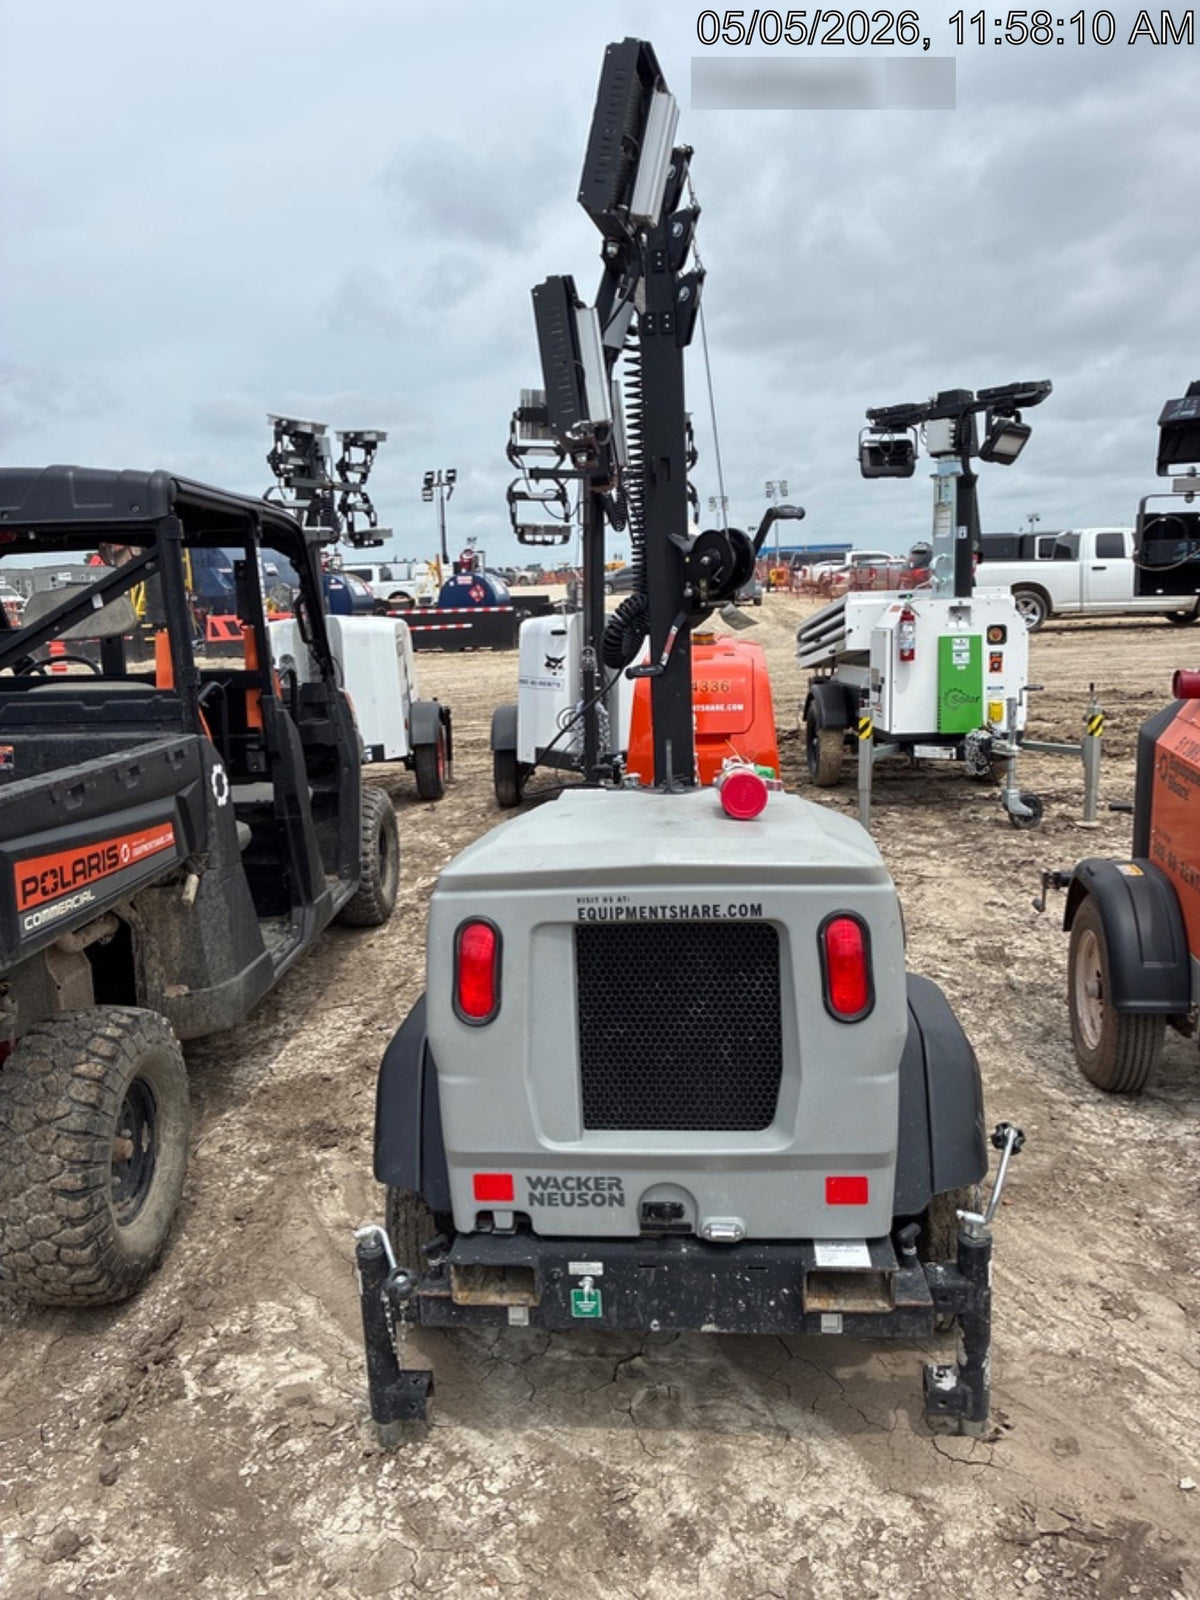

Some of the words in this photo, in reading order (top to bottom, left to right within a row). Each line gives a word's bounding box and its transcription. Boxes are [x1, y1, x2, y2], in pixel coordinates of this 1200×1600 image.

[21, 844, 120, 905] POLARIS
[24, 889, 97, 931] COMMERCIAL
[577, 903, 763, 921] EQUIPMENTSHARE.COM
[525, 1176, 625, 1192] WACKER
[528, 1191, 626, 1208] NEUSON
